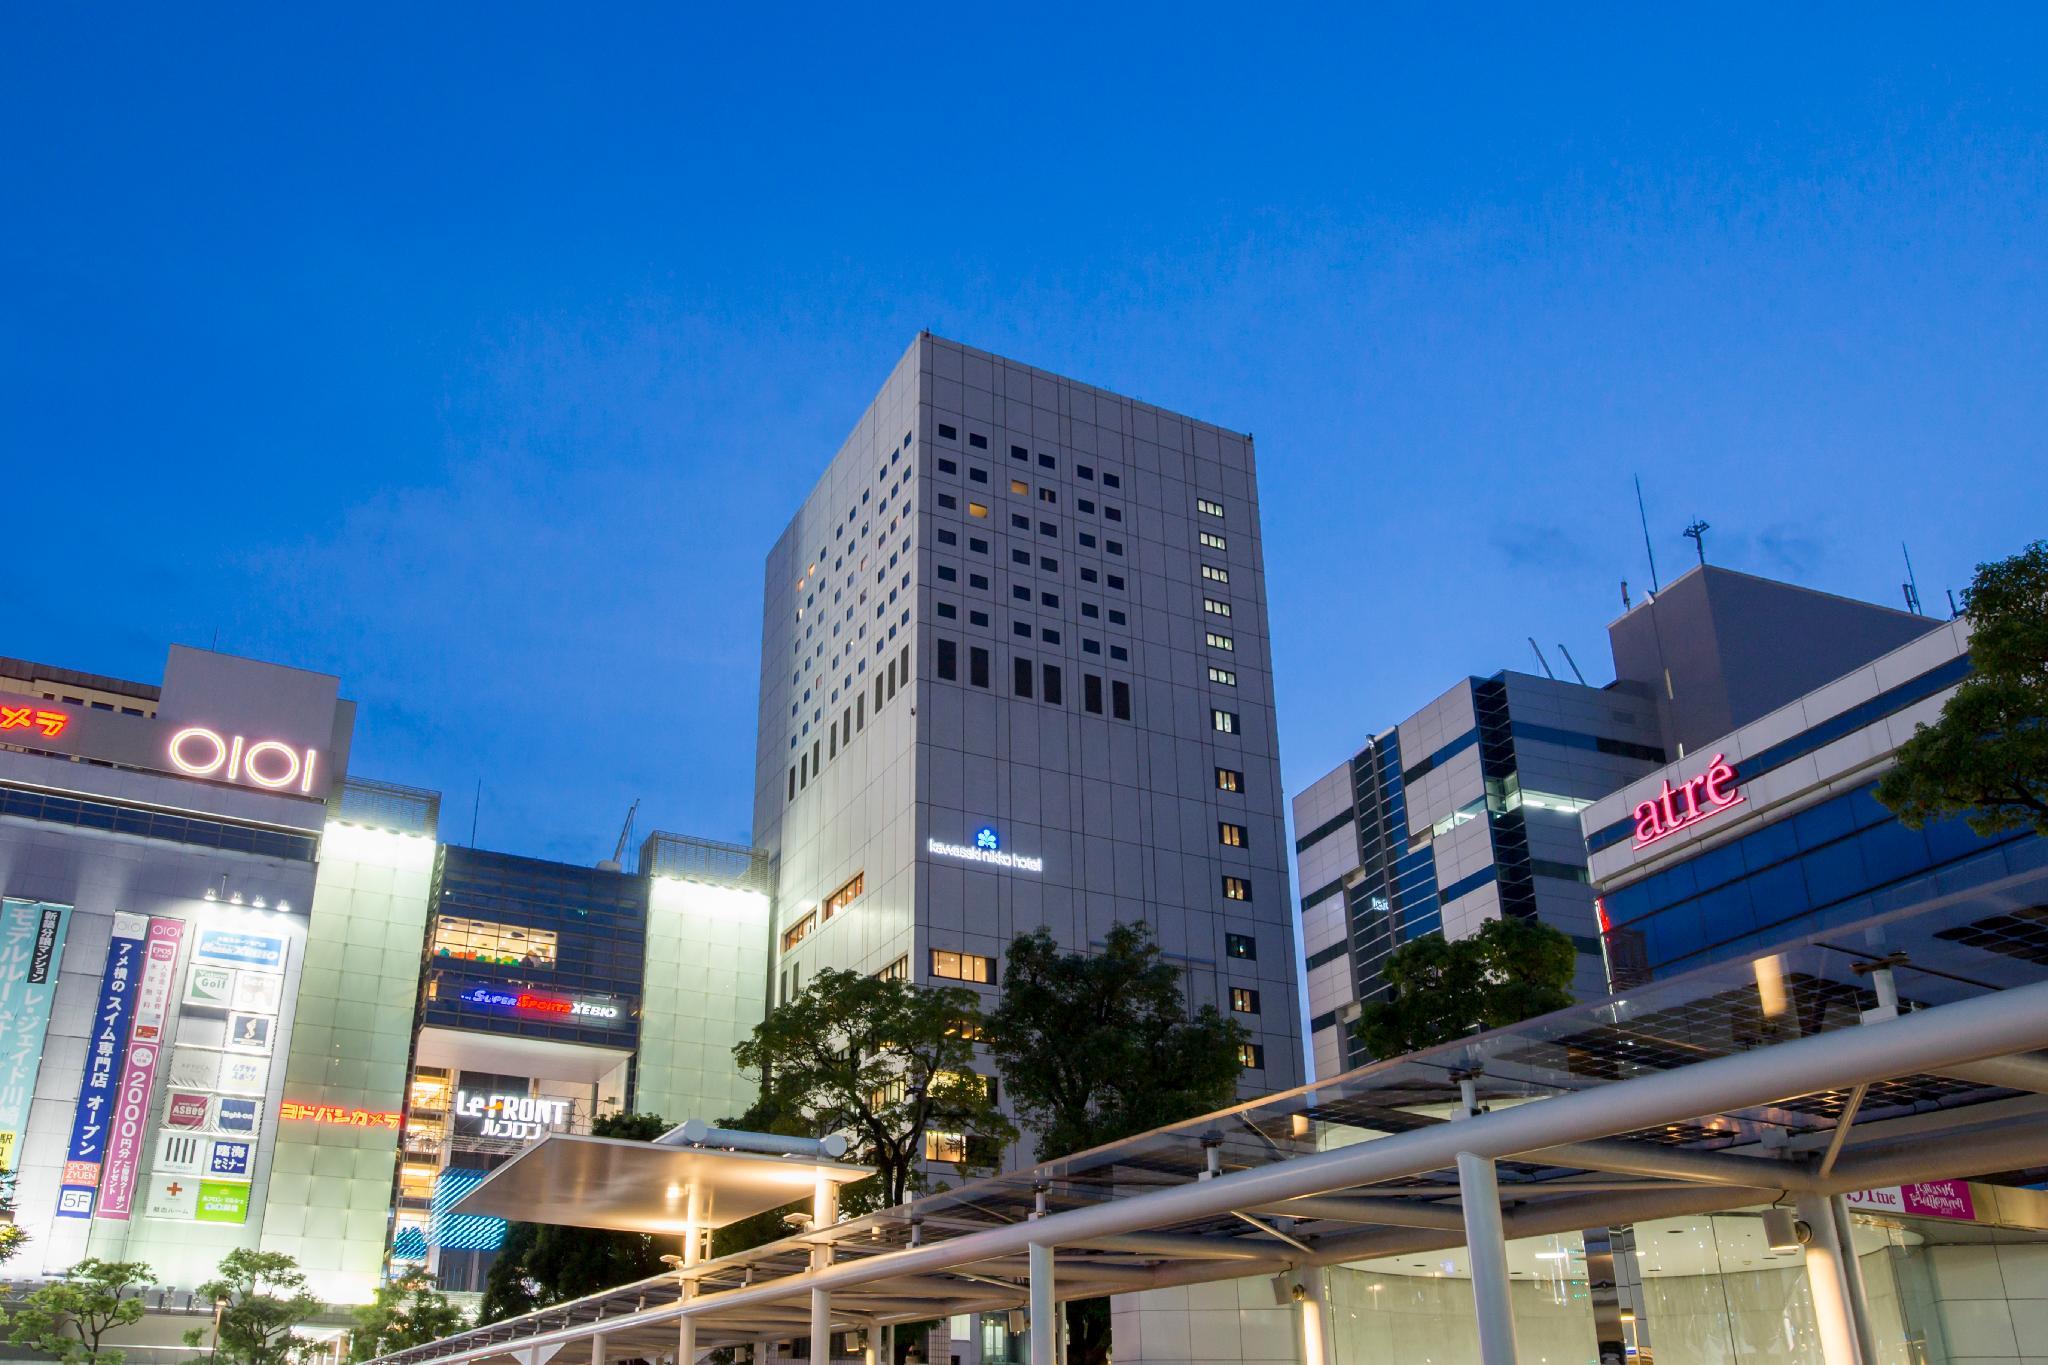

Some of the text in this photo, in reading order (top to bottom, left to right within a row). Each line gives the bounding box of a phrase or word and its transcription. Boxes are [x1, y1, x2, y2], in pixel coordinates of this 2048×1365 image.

[1634, 753, 1738, 842] atré
[929, 838, 1043, 872] kawasaki nikko hotel
[111, 943, 133, 993] アメ横の
[201, 978, 226, 989] Golf
[571, 1001, 617, 1018] XEBIO
[90, 996, 122, 1089] スイム専門店
[280, 1103, 401, 1129] ヨドバシカメラ
[79, 1095, 104, 1156] オープン
[67, 1163, 98, 1173] SPORTS
[214, 1157, 245, 1170] セミナー
[65, 1170, 96, 1180] ZYUEN
[63, 1193, 90, 1209] 5F
[1876, 1191, 1896, 1205] tue
